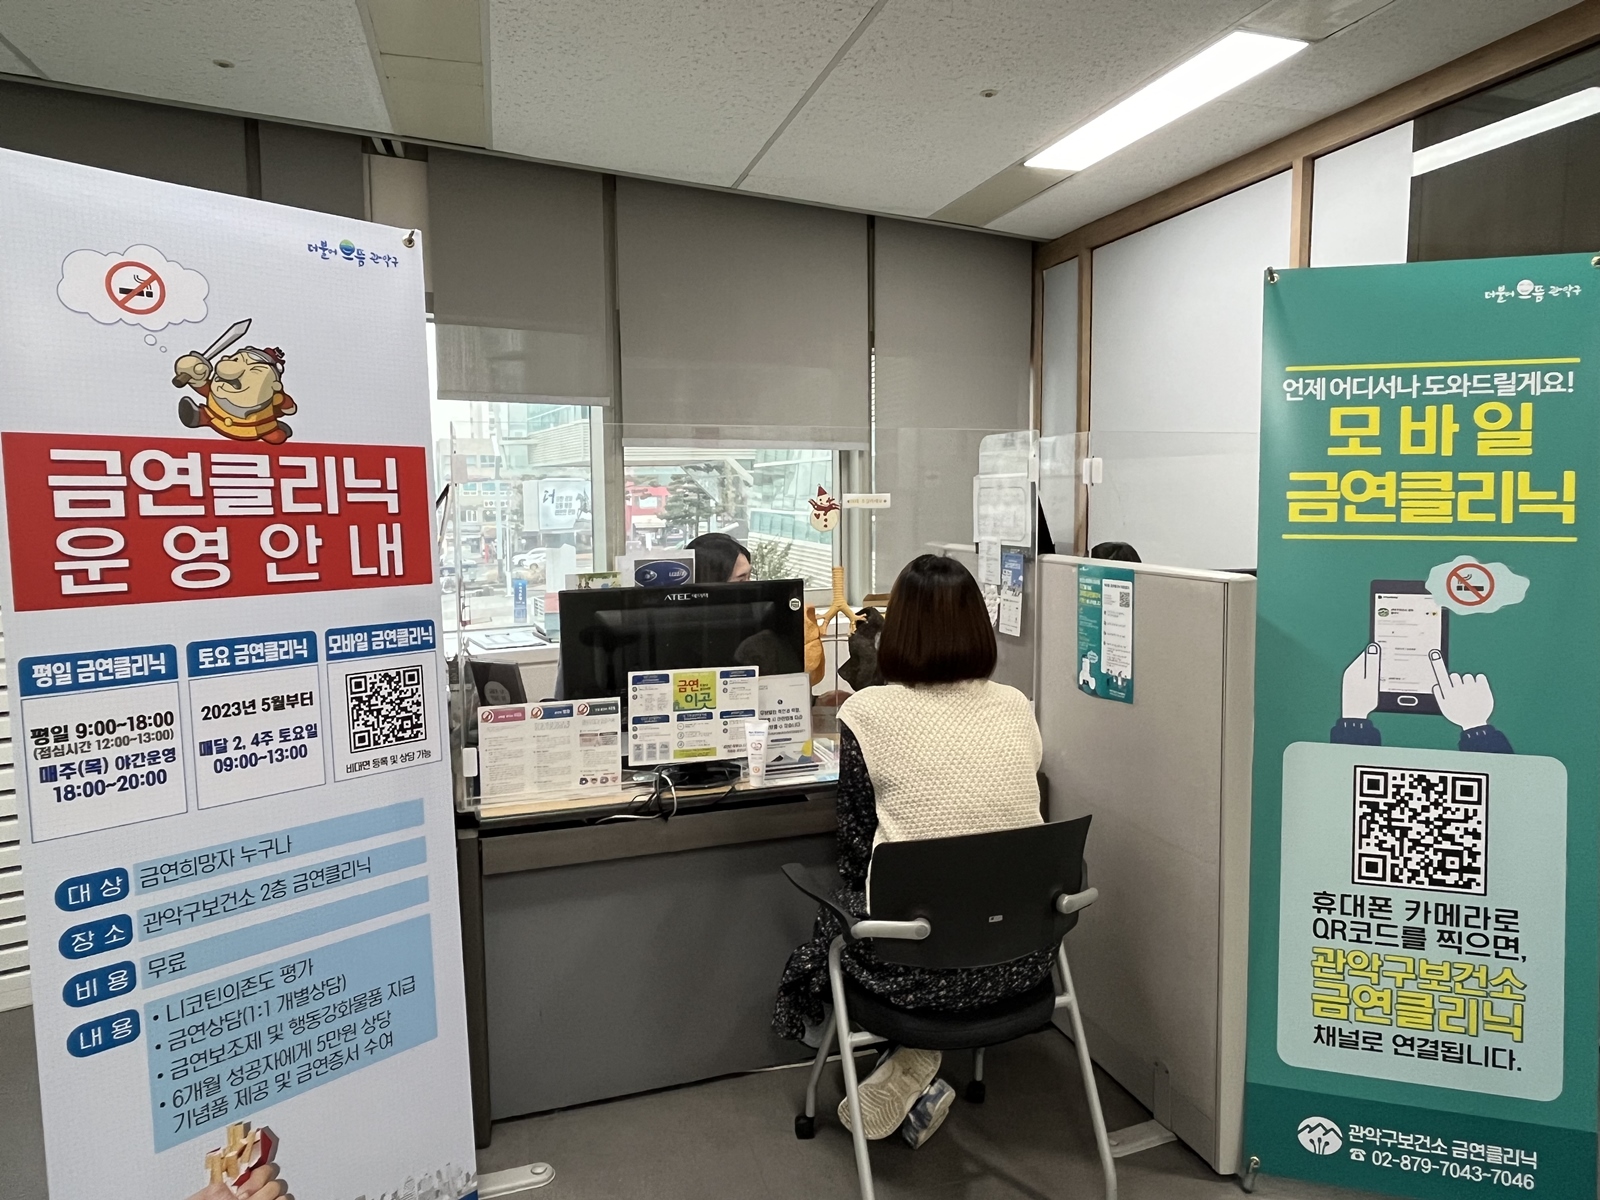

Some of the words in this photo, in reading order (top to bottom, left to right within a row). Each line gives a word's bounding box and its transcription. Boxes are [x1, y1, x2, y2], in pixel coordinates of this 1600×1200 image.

[307, 240, 338, 260] 더불어
[369, 252, 399, 268] 관악구
[1484, 284, 1515, 303] 더불어
[1548, 284, 1582, 298] 관악구
[1282, 380, 1326, 401] 언제
[1330, 376, 1421, 400] 어디서나
[1422, 371, 1575, 397] 도와드릴게요!
[47, 448, 400, 519] 금연클리닉
[1286, 469, 1577, 525] 금연클리닉
[664, 592, 691, 601] ATEC
[198, 645, 231, 670] 토요
[233, 638, 309, 665] 금연클리닉
[328, 633, 369, 656] 모바일
[371, 626, 434, 650] 금연클리닉
[31, 661, 72, 689] 평일
[76, 653, 167, 683] 금연클리닉
[677, 678, 699, 693] 금연
[200, 698, 257, 721] 2023년
[261, 691, 315, 713] 5월부터
[30, 722, 70, 746] 평일
[75, 711, 175, 740] 9:00~18:00
[33, 738, 93, 761] (점심시간
[94, 728, 175, 752] 12:00~13:00)
[199, 738, 230, 757] 매달
[232, 734, 248, 752] 2,
[250, 730, 275, 750] 4주
[278, 723, 319, 745] 토요일
[39, 759, 109, 785] 매주(목)
[115, 747, 177, 771] 야간운영
[213, 744, 309, 774] 09:00~13:00
[345, 761, 371, 774] 비대면
[372, 758, 389, 771] 등록
[390, 756, 399, 767] 및
[399, 752, 416, 766] 상담
[416, 748, 432, 761] 가능
[52, 769, 168, 803] 18:00~20:00
[139, 850, 236, 890] 금연희망자
[240, 835, 293, 865] 누구나
[143, 889, 256, 934] 관악구보건소
[261, 875, 288, 902] 2층
[292, 857, 372, 894] 금연클리닉
[1311, 890, 1394, 920] 휴대폰
[1405, 899, 1520, 933] 카메라로
[1312, 917, 1427, 952] QR코드를
[1436, 930, 1527, 963] 찍으면,
[147, 951, 187, 979] 무료
[1310, 946, 1527, 1001] 관악구보건소
[165, 974, 275, 1023] 니코틴의존도
[280, 958, 314, 986] 평가
[168, 1002, 270, 1052] 금연상담(1:1
[277, 974, 347, 1012] 개별상담)
[170, 1030, 262, 1081] 금연보조제
[267, 1023, 283, 1041] 및
[288, 989, 383, 1038] 행동강화물품
[387, 976, 417, 1000] 지급
[1310, 979, 1524, 1043] 금연클리닉
[172, 1073, 222, 1110] 6개월
[225, 1040, 313, 1089] 성공자에게
[316, 1023, 358, 1053] 5만원
[360, 1010, 392, 1039] 상당
[1312, 1024, 1384, 1054] 채널로
[1391, 1033, 1523, 1072] 연결됩니다.
[173, 1098, 230, 1134] 기념품
[233, 1083, 270, 1113] 제공
[274, 1071, 291, 1091] 및
[295, 1045, 360, 1084] 금연증서
[363, 1031, 395, 1058] 수여
[1348, 1123, 1448, 1156] 관악구보건소
[1451, 1140, 1538, 1170] 금연클리닉
[1371, 1150, 1535, 1190] 02-879-7043~7046
